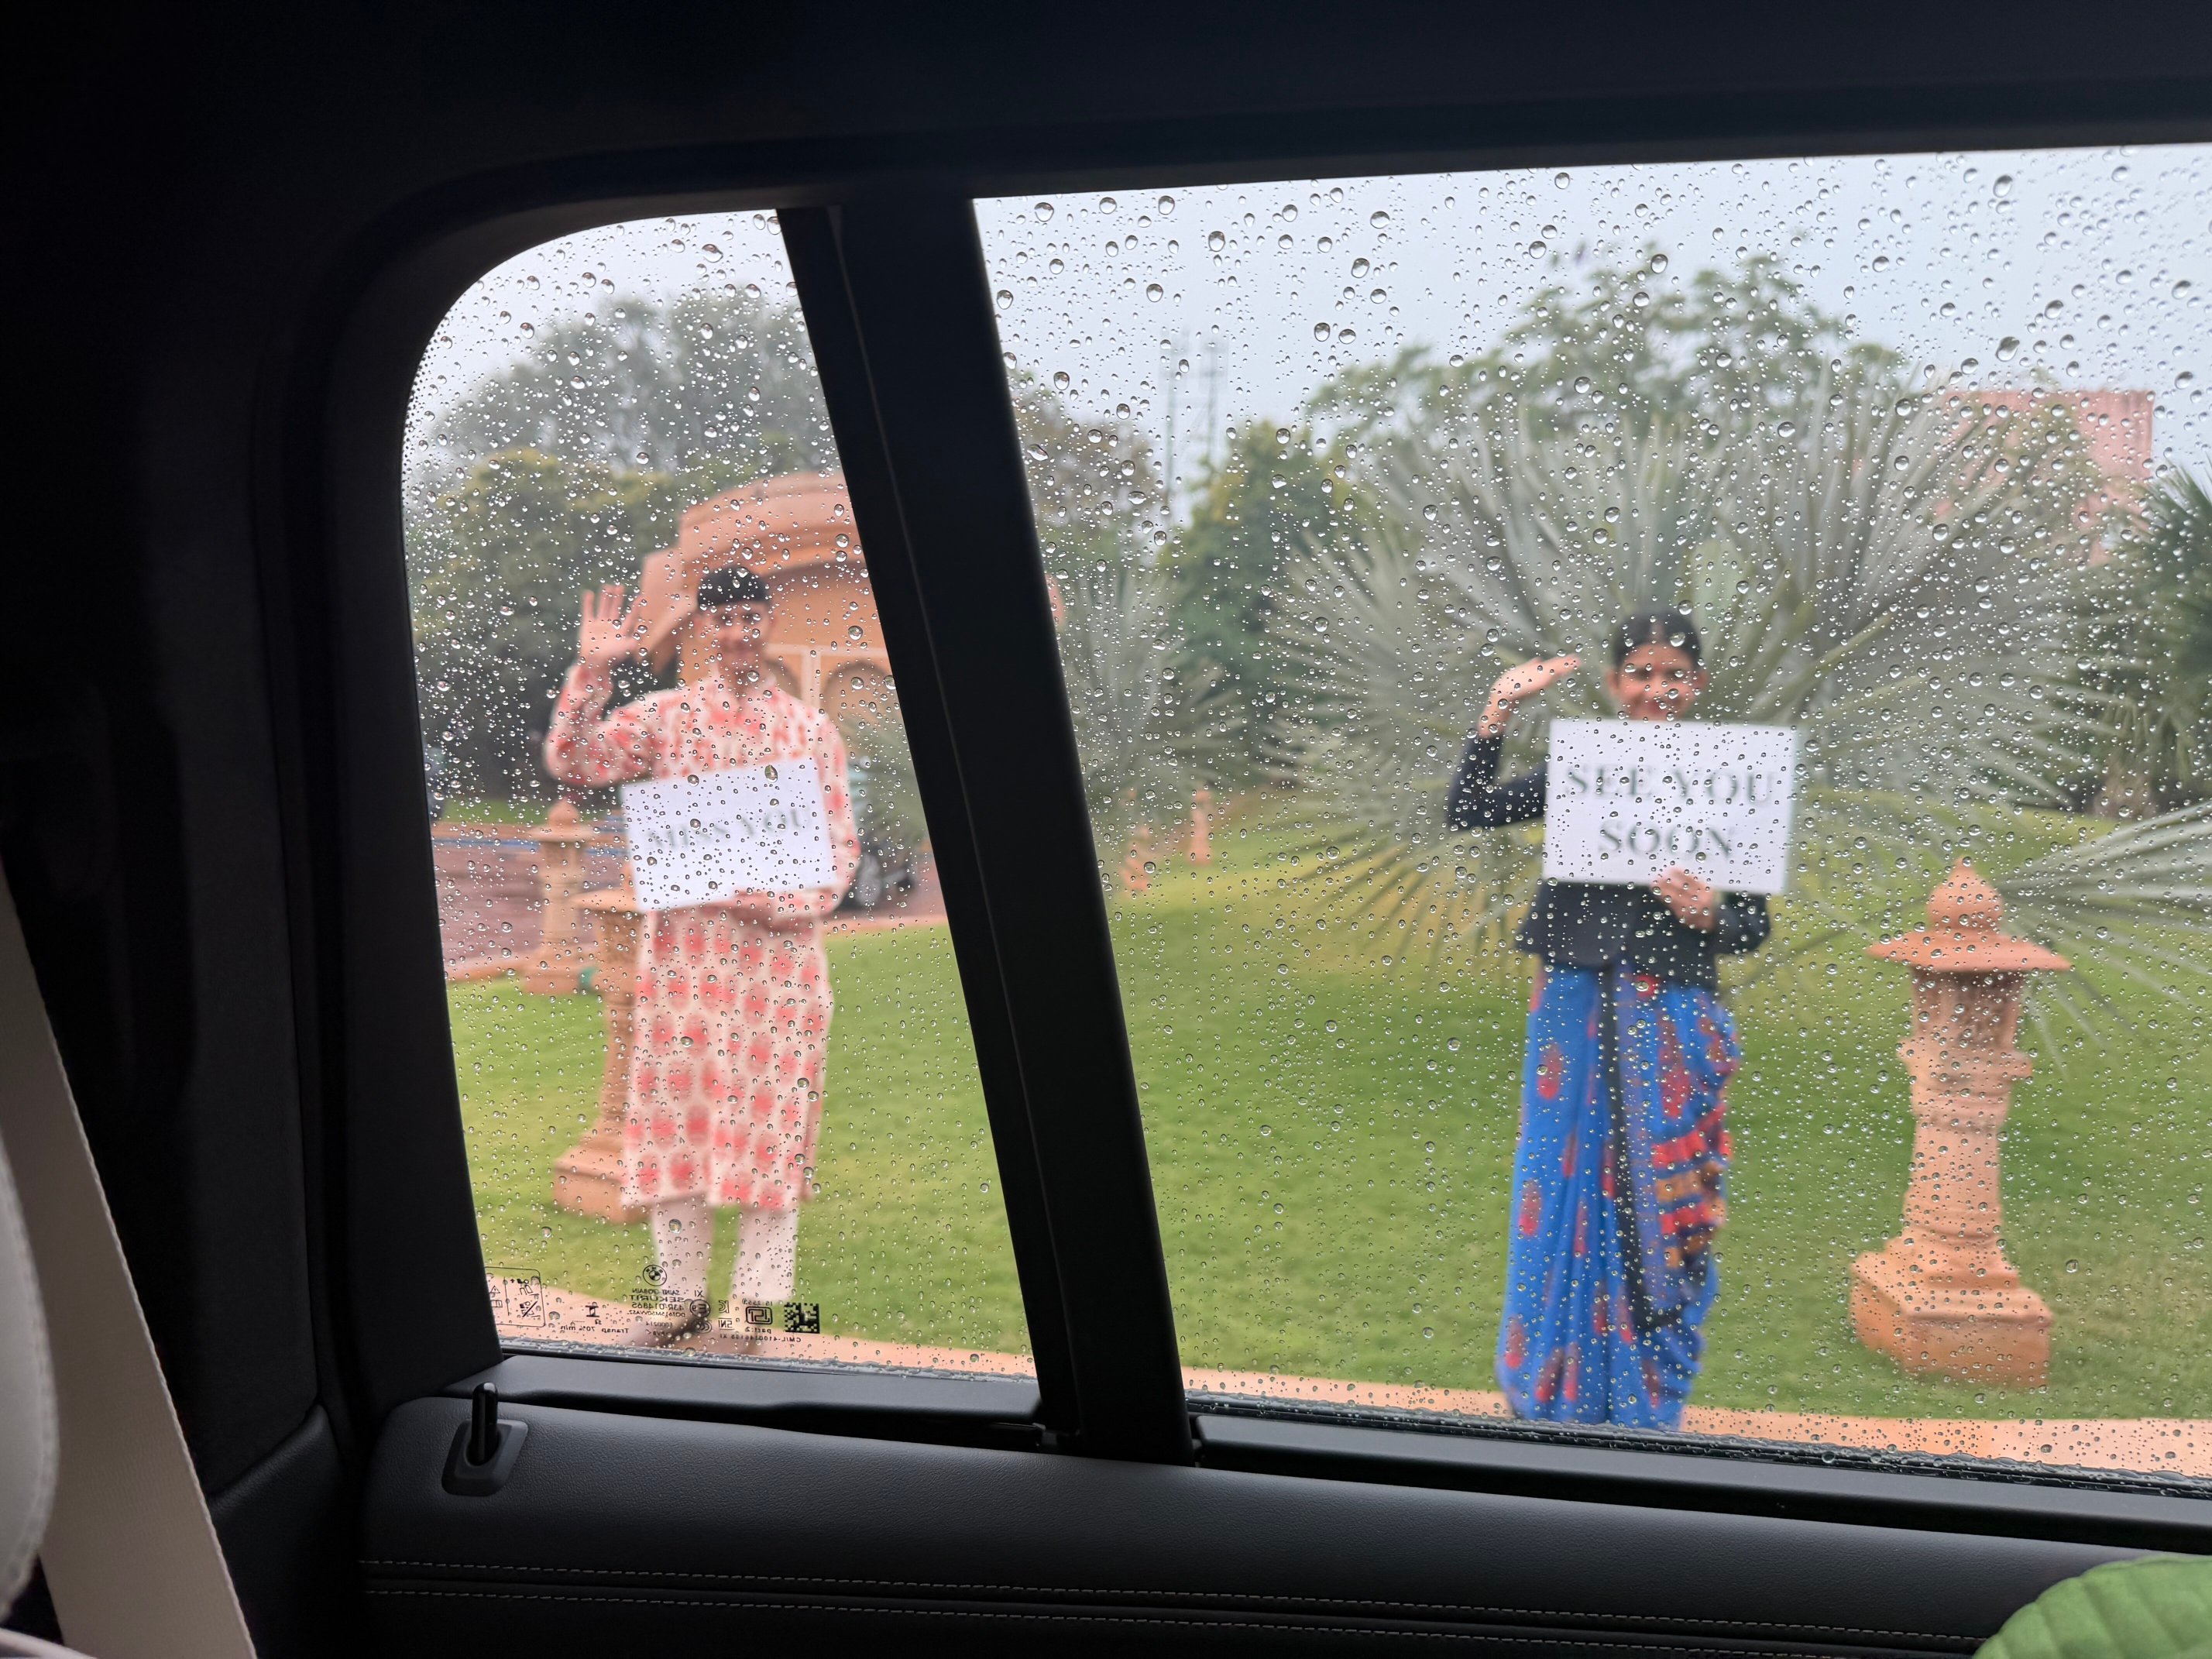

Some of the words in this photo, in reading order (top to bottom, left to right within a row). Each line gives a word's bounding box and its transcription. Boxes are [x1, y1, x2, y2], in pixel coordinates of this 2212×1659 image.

[1565, 764, 1656, 799] SEE
[1670, 765, 1777, 806] YOU
[733, 805, 813, 838] YOU
[1599, 818, 1738, 860] SOON
